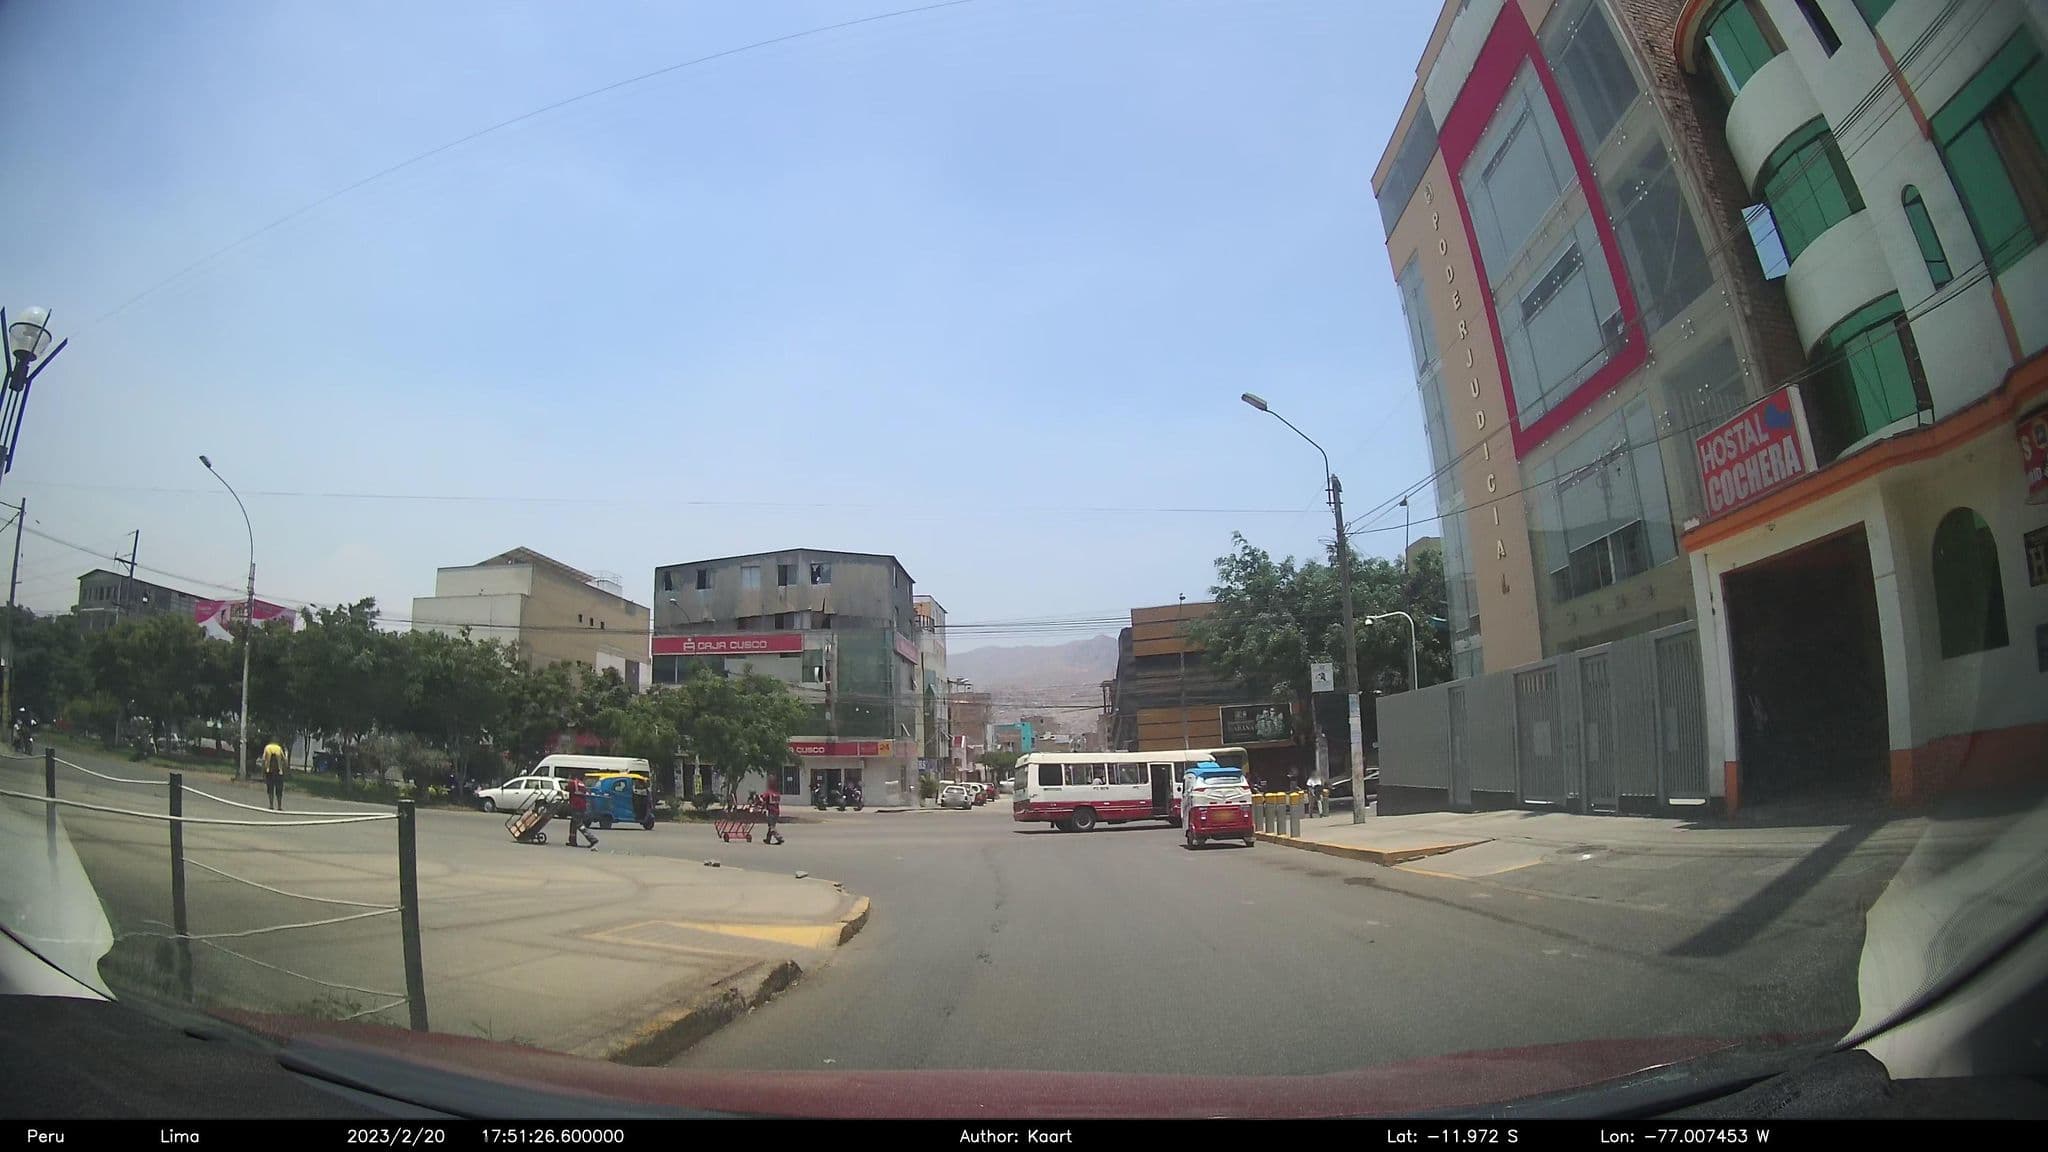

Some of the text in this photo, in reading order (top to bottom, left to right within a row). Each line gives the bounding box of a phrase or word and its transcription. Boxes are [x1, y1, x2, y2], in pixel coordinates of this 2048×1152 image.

[1432, 211, 1511, 595] PODER JUDICIAL
[1701, 412, 1769, 474] HOSTAL
[1708, 435, 1802, 511] COCHERA
[697, 640, 768, 650] CAJA CUSCO
